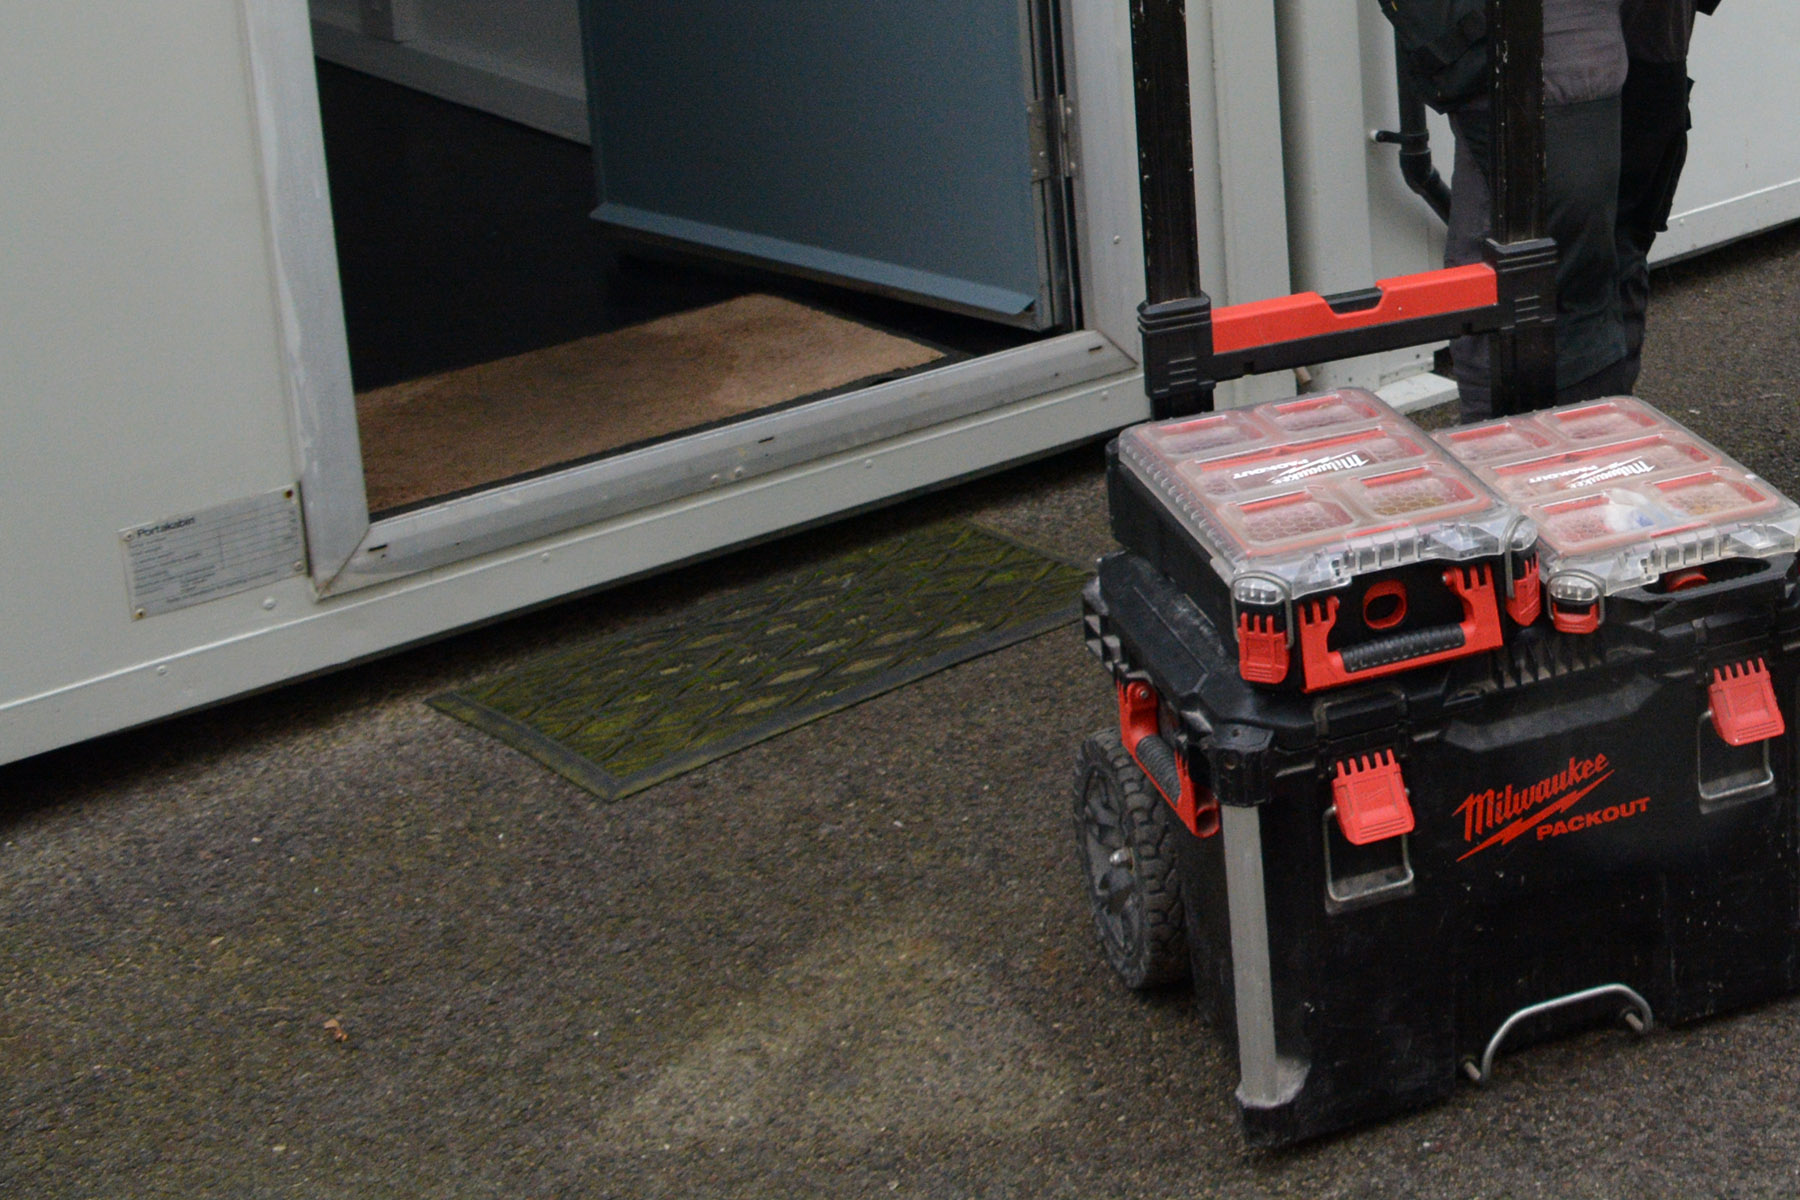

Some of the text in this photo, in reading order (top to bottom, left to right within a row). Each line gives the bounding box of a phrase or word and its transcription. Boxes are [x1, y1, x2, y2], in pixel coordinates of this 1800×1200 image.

[1270, 454, 1369, 485] Milwaukee
[1451, 752, 1609, 843] Milwaukee
[1536, 796, 1651, 841] PACKOUT
